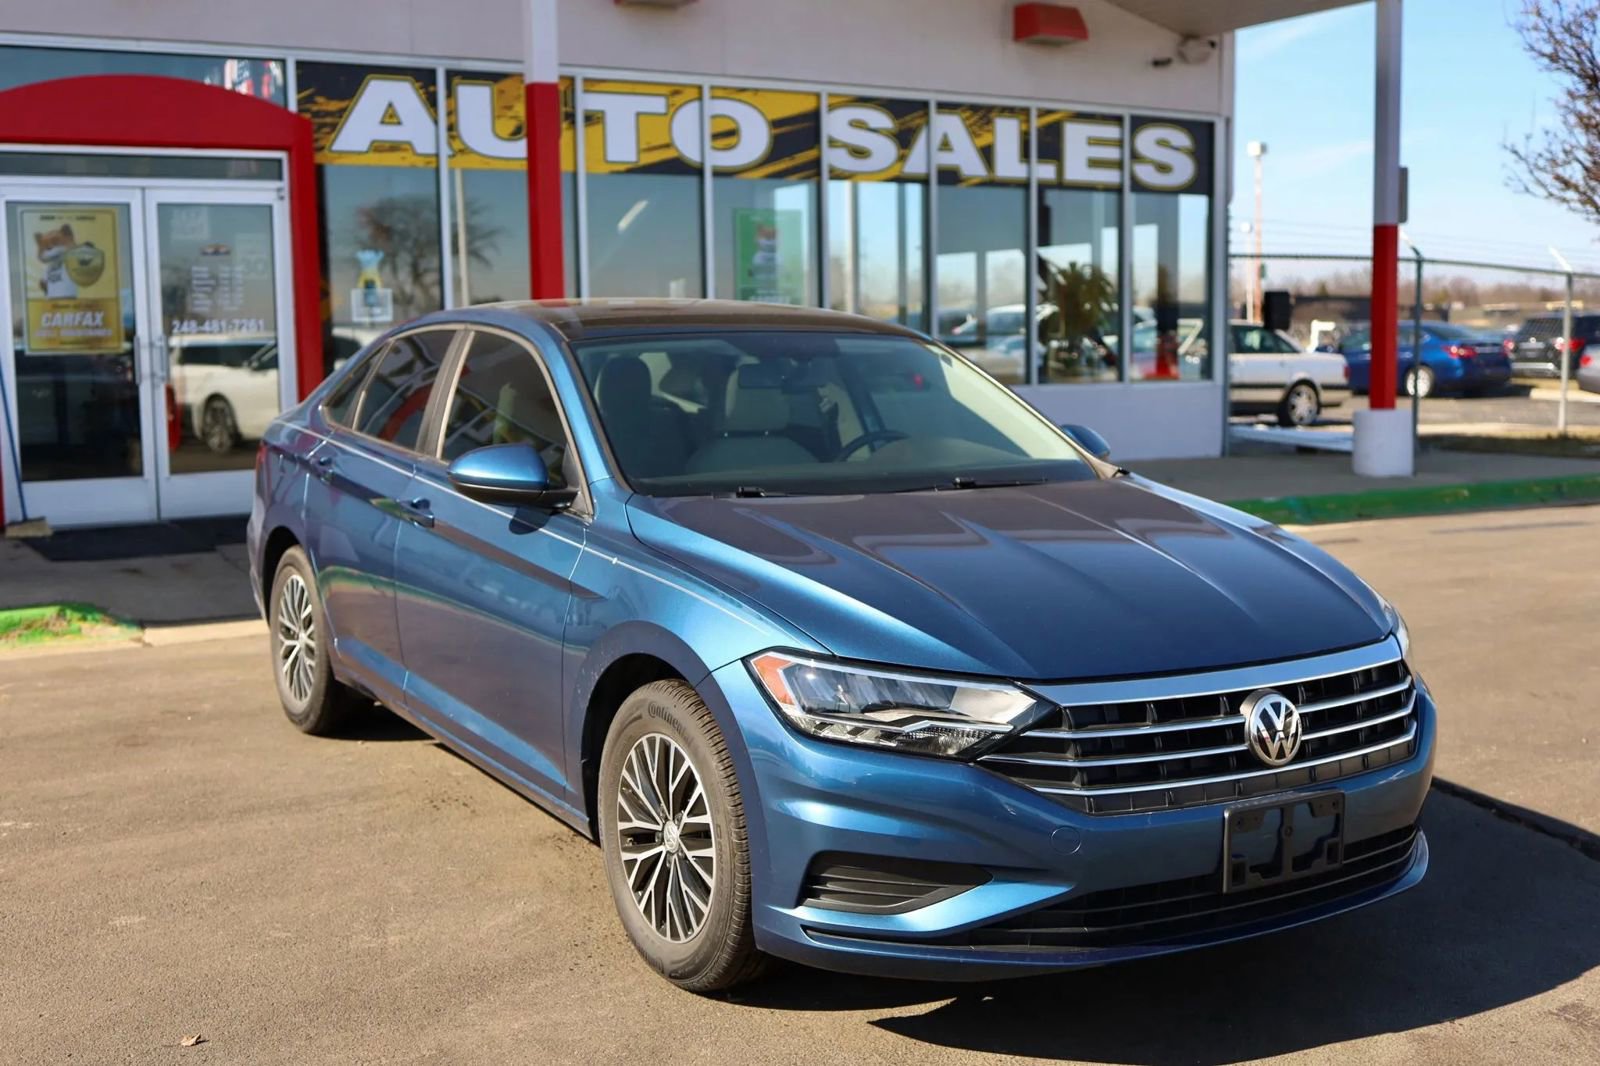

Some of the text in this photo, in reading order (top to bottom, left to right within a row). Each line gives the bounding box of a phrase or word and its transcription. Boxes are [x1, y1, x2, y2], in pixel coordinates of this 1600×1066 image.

[327, 75, 1197, 190] AUTO SALES
[41, 311, 104, 327] CARFAX
